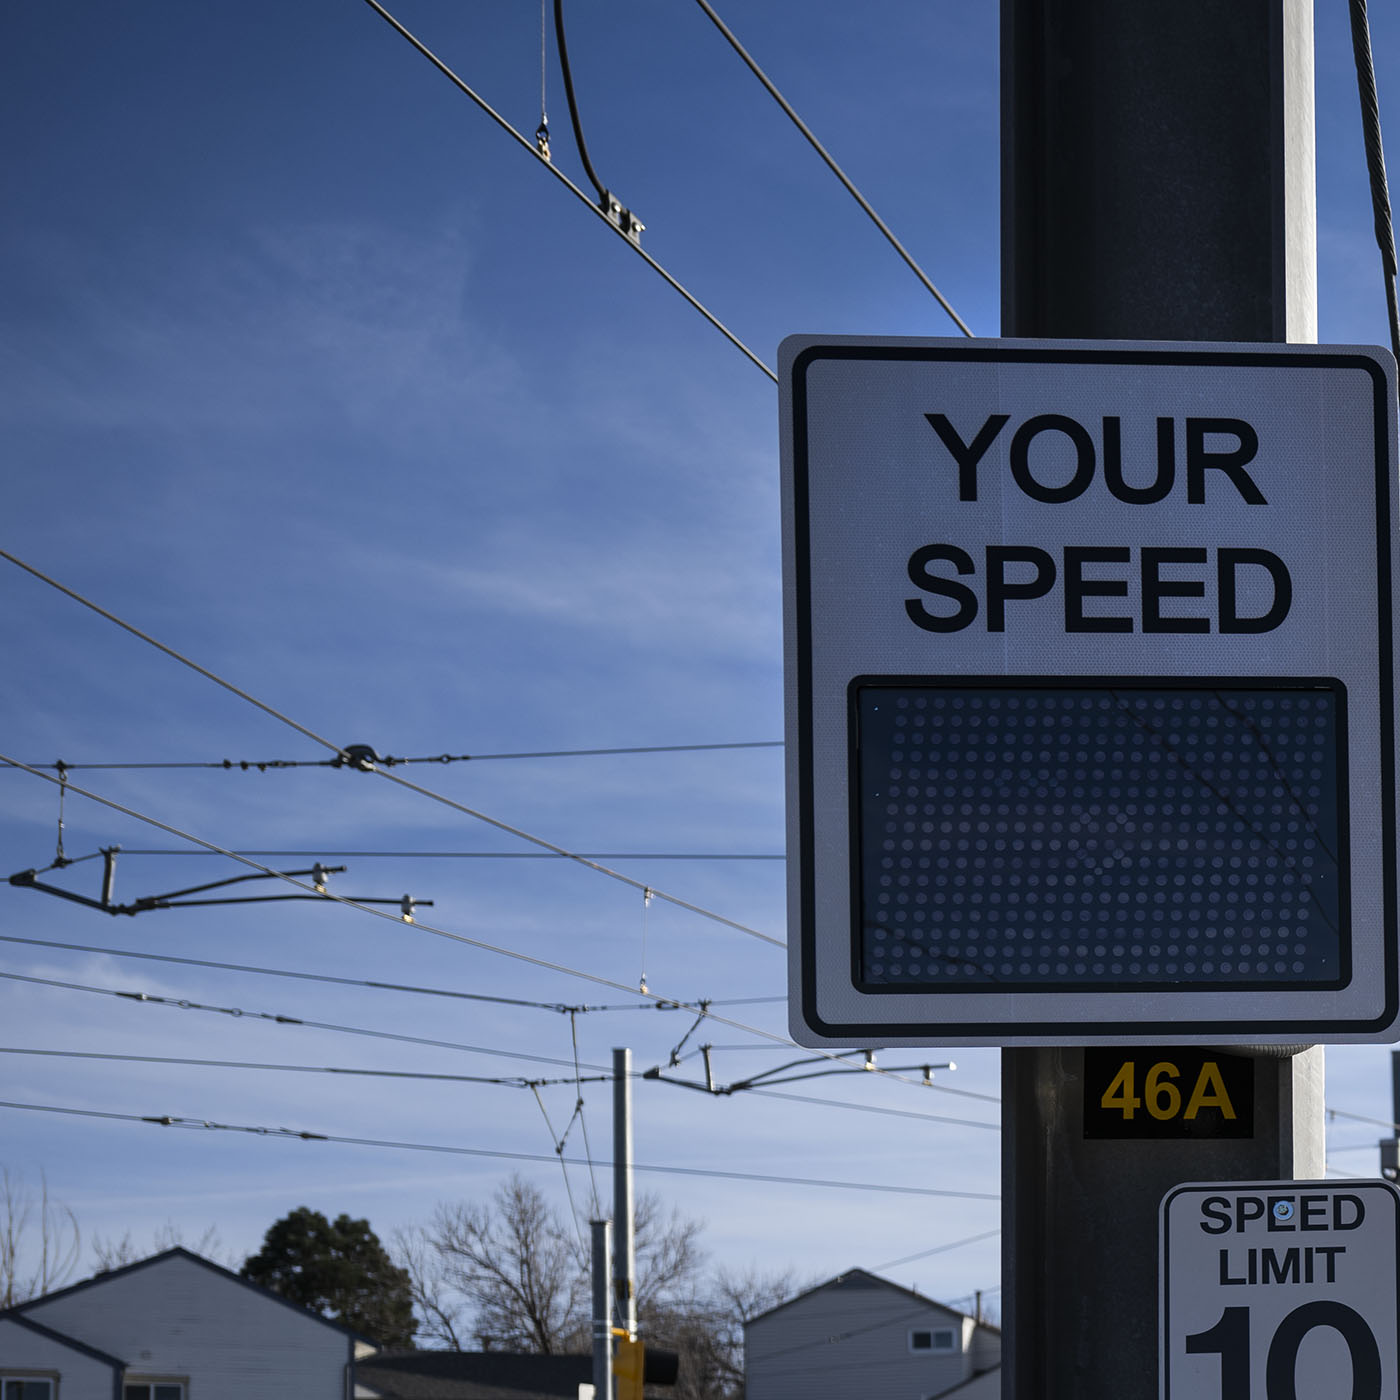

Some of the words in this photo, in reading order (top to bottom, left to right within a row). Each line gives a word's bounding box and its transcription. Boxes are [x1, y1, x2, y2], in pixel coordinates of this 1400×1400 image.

[924, 414, 1268, 505] YOUR
[905, 544, 1292, 634] SPEED
[1101, 1061, 1236, 1120] 46A
[1200, 1194, 1365, 1234] SPEED
[1219, 1246, 1346, 1286] LIMIT
